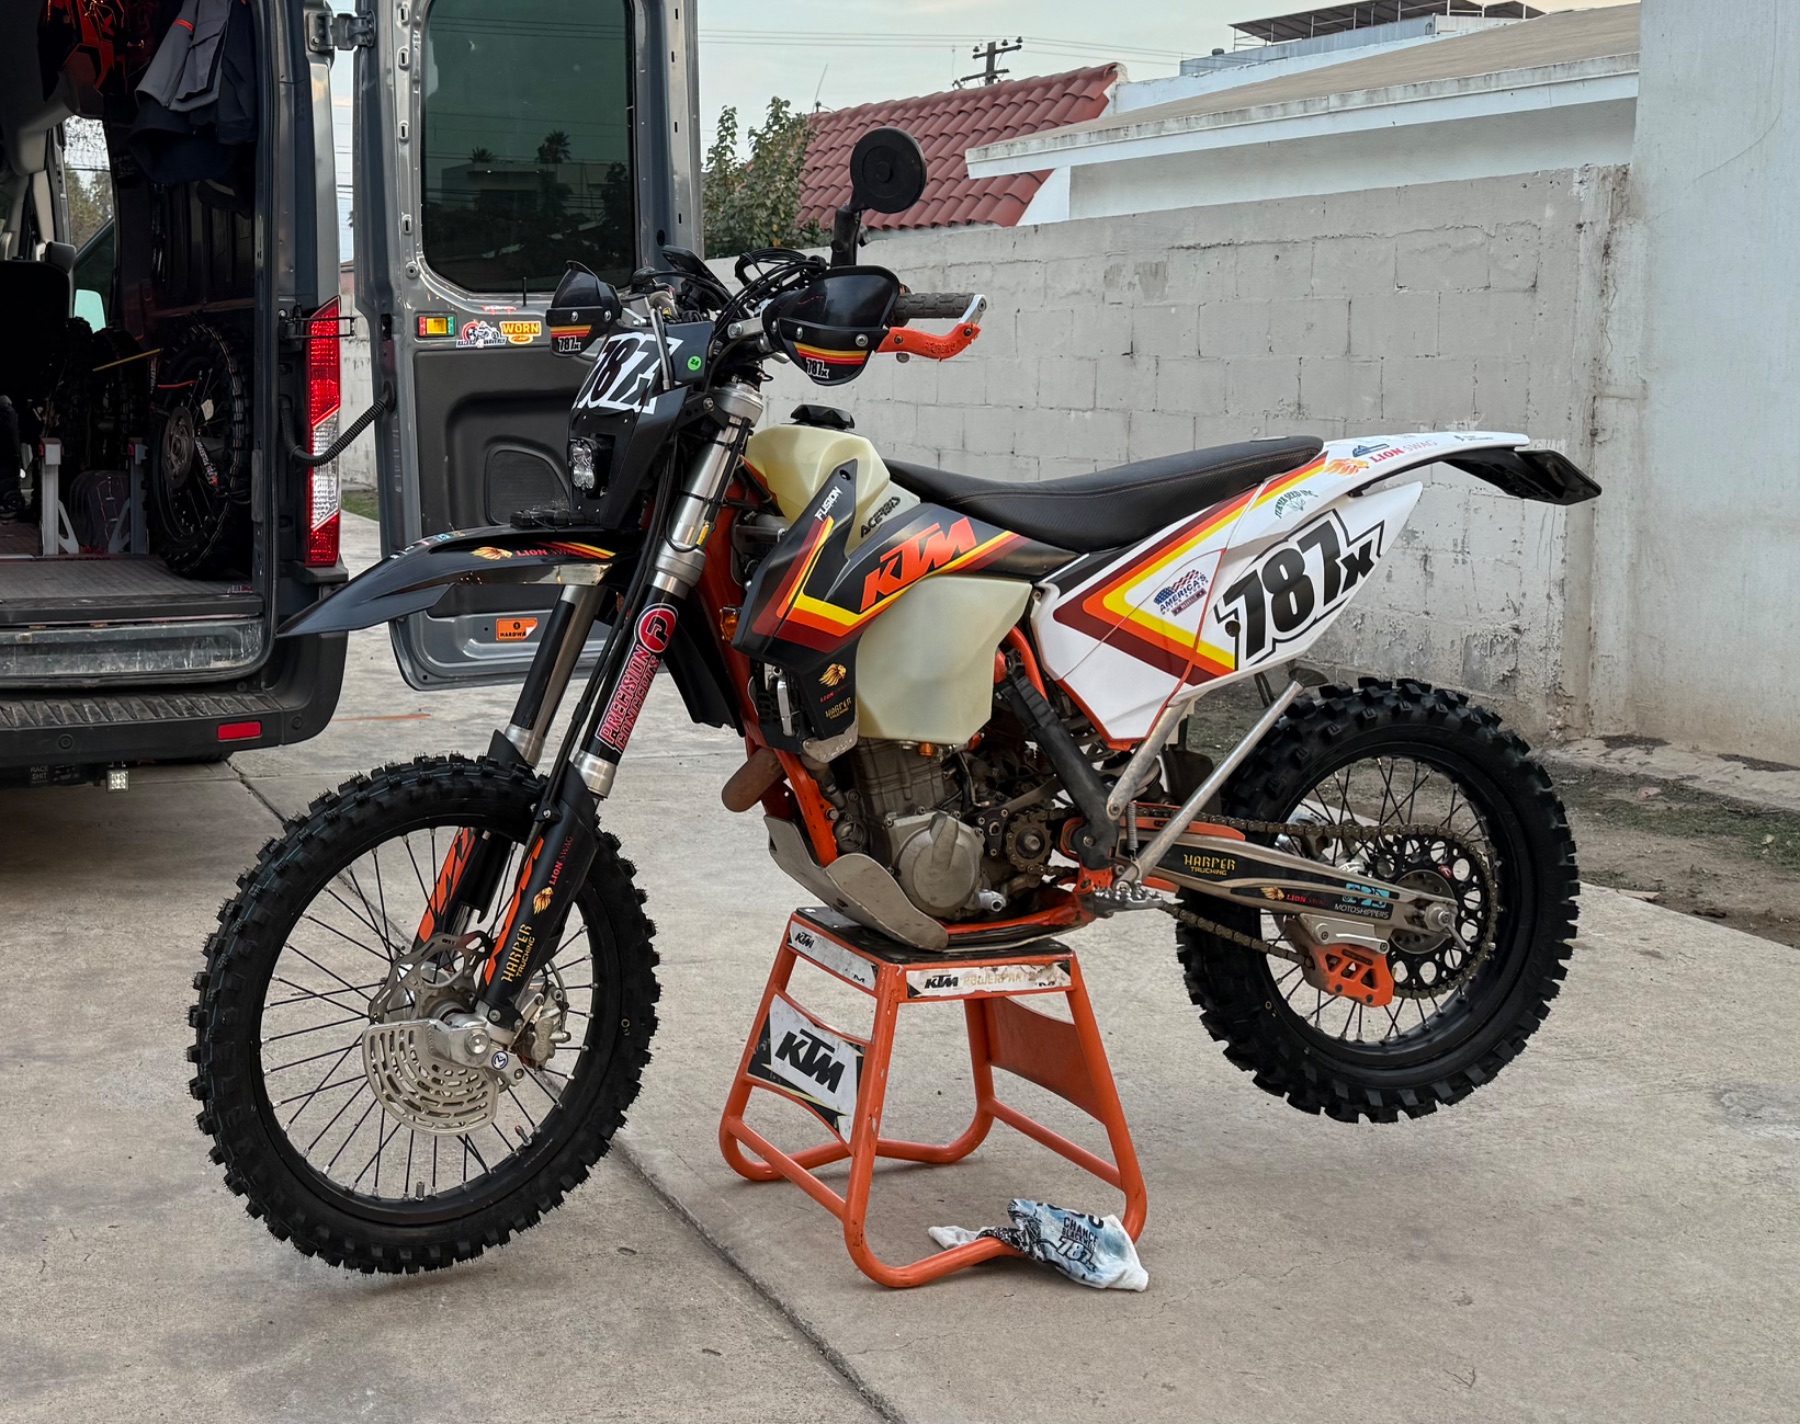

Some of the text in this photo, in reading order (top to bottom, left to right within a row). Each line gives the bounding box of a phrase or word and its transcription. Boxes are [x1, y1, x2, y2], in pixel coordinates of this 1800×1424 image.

[502, 323, 539, 333] WORN
[1368, 448, 1405, 464] LION
[1404, 439, 1437, 454] SWAG
[814, 486, 843, 522] FUSION
[860, 496, 901, 538] ACERBIS
[516, 549, 548, 557] LION
[860, 516, 977, 614] KTM
[1160, 573, 1207, 613] AMERICA'S
[600, 643, 650, 744] PRECISION
[614, 654, 660, 751] CONCEPTS
[549, 836, 573, 886] LION SWAG
[1183, 853, 1236, 871] HARPER
[1286, 893, 1307, 903] LION
[1334, 903, 1389, 919] MOTOSHIPPERS
[501, 923, 532, 983] HARPER
[794, 931, 815, 949] KTM
[924, 974, 959, 989] KTM
[774, 1028, 846, 1094] KTM
[1063, 1216, 1099, 1243] CHANCE
